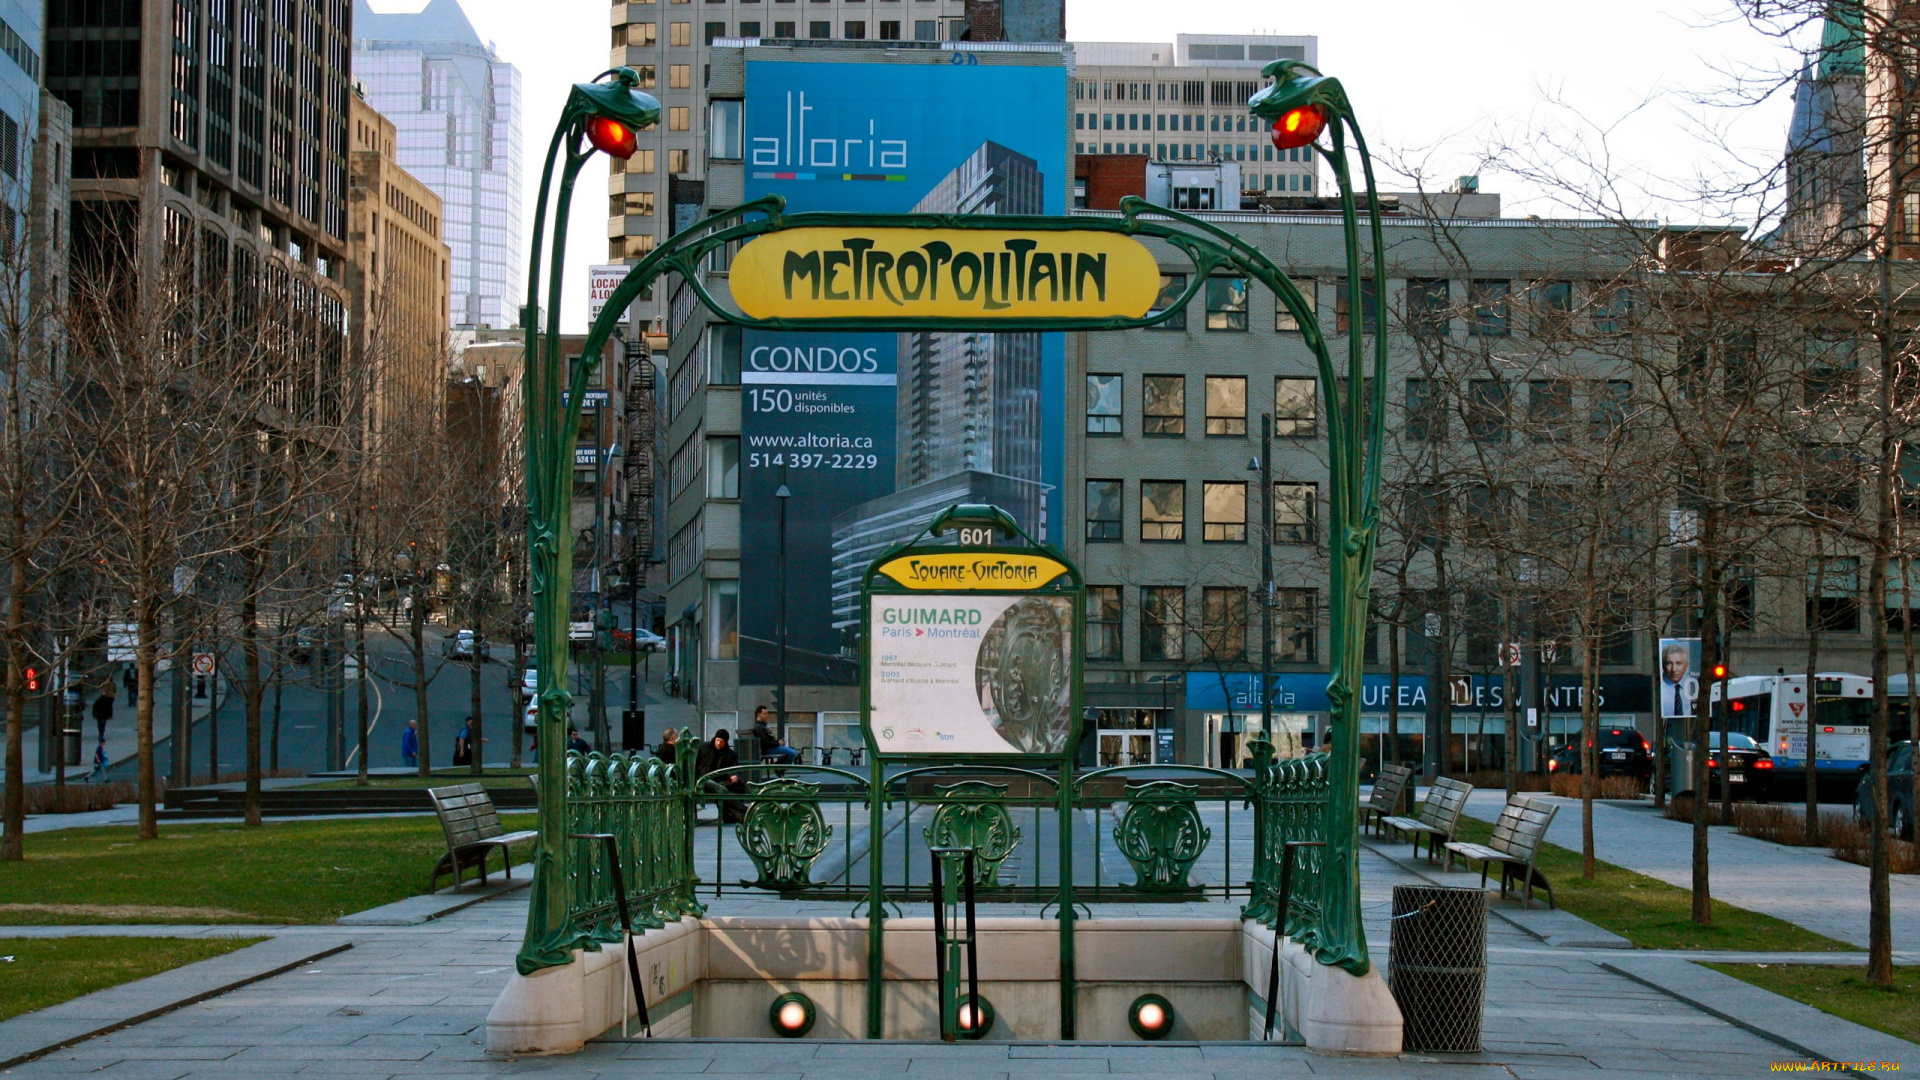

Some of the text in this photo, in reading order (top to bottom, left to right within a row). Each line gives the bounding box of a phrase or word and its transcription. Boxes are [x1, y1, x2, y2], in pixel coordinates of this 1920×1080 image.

[753, 91, 907, 168] altoria
[783, 237, 1107, 310] METROPOLITAIN
[750, 346, 878, 373] CONDOS
[749, 389, 827, 412] 150 unités
[795, 402, 855, 415] disponibles
[750, 432, 873, 448] www.altoria.ca
[750, 453, 878, 469] 514 397-2229
[960, 528, 992, 545] 601
[909, 560, 1037, 582] SQUARE-VICTORIA
[883, 608, 982, 625] GUIMARD
[882, 627, 980, 638] Paris Montréal
